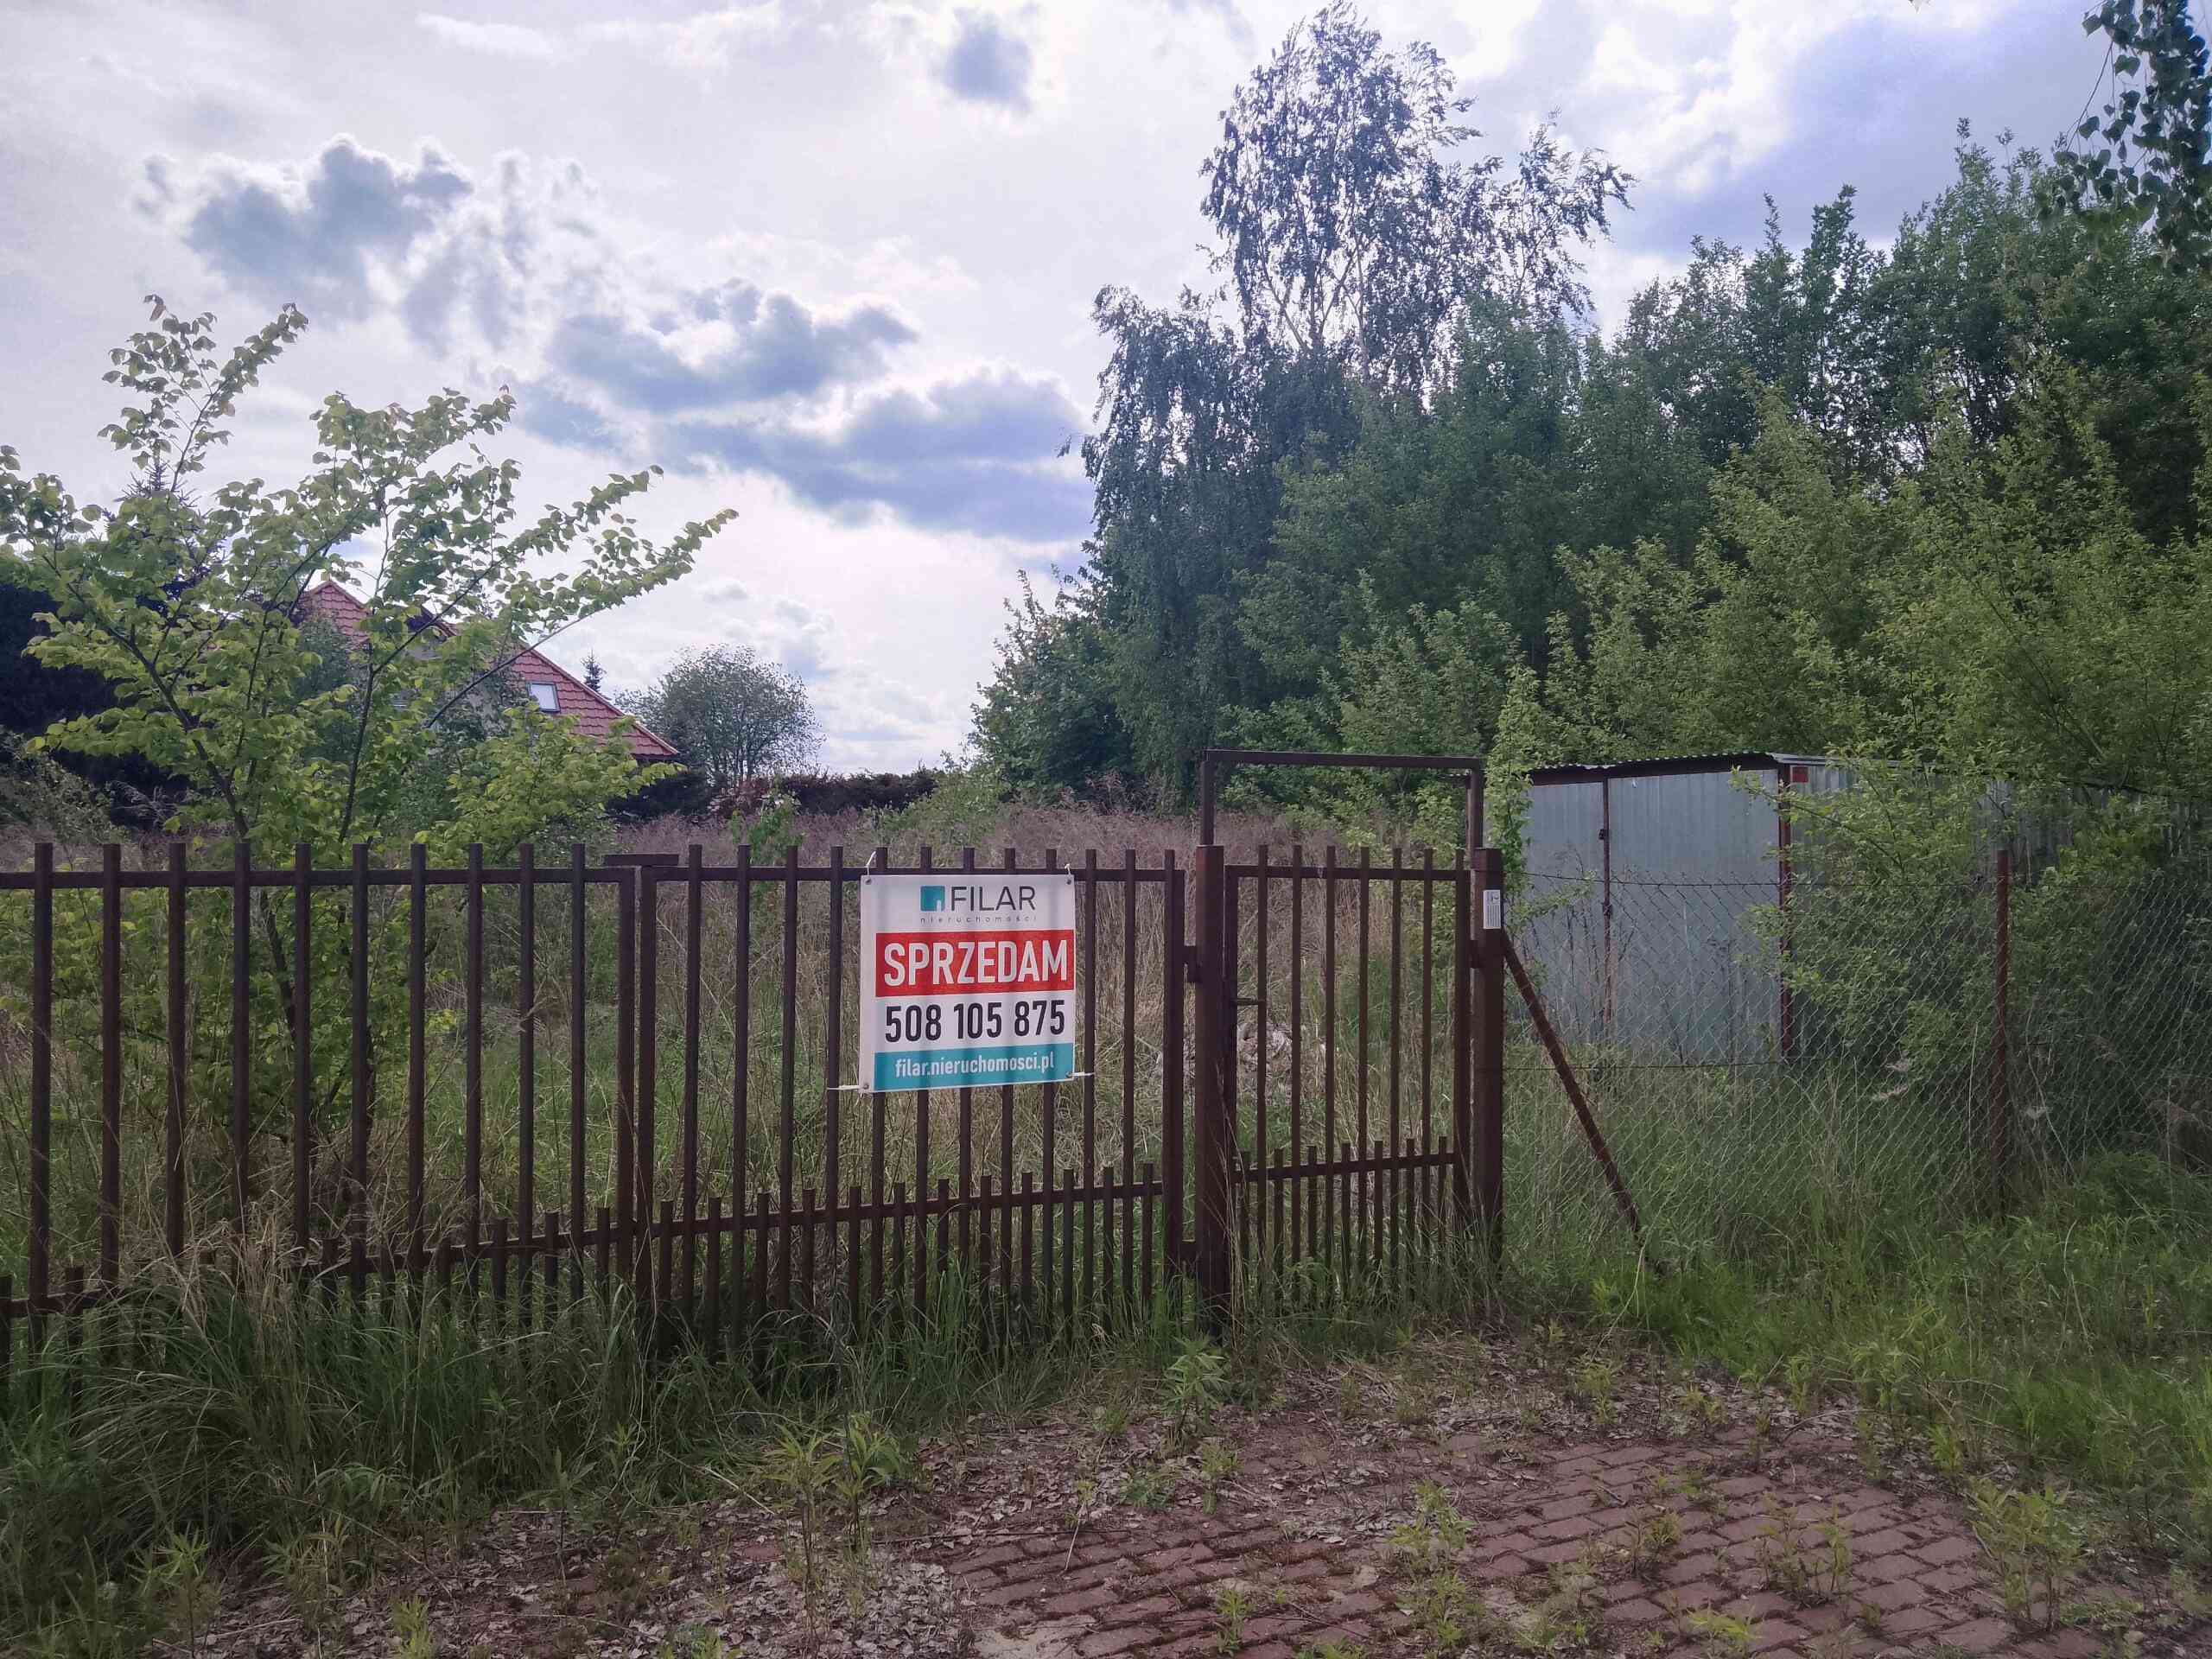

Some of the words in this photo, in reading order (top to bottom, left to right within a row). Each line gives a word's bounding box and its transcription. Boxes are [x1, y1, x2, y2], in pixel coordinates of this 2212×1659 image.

[950, 886, 1036, 911] FILAR
[884, 940, 1067, 986] SPRZEDAM
[885, 1004, 942, 1042] 508
[953, 1001, 1002, 1039] 105
[1014, 1000, 1065, 1036] 875
[894, 1052, 1054, 1078] filar.nieruchomosci.pl
